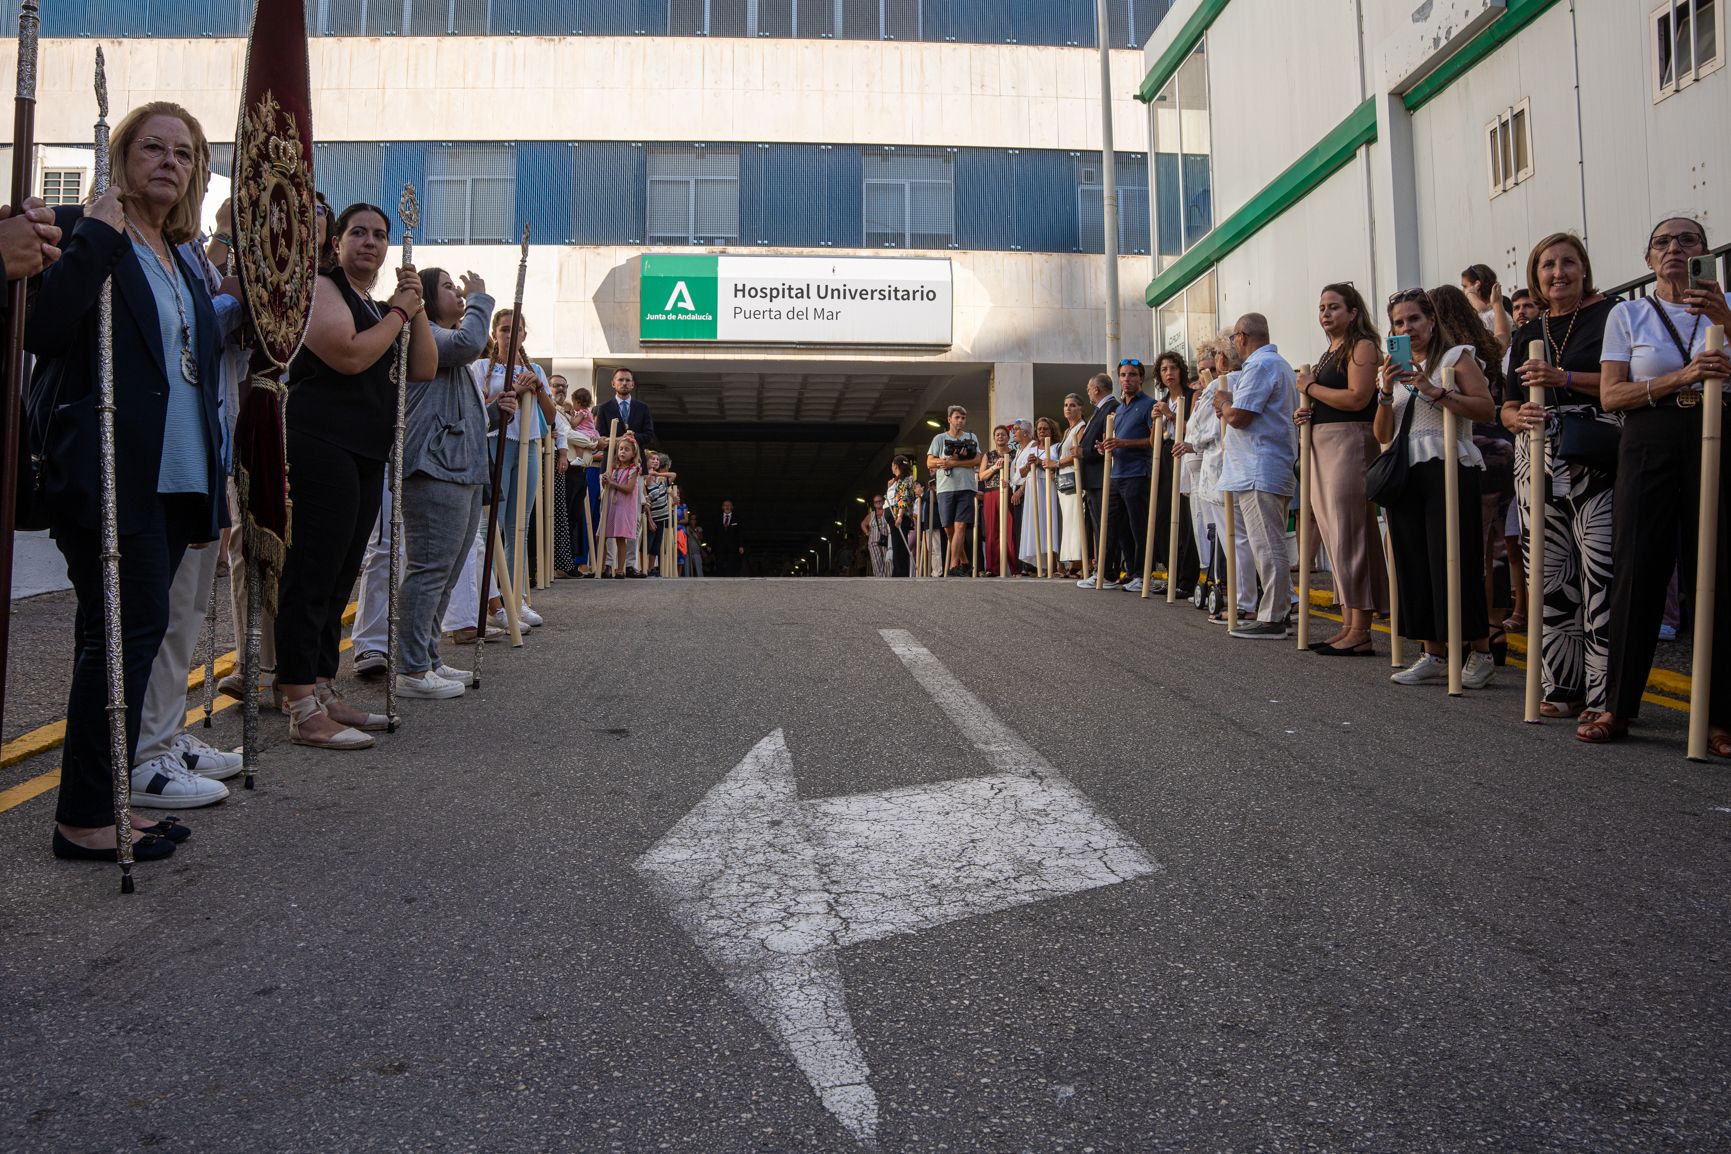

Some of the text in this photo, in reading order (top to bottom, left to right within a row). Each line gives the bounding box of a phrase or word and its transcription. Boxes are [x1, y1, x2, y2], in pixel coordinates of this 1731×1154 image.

[733, 283, 937, 303] Hospital Universitario
[646, 313, 666, 321] Junta
[677, 312, 713, 321] Andalucía
[733, 306, 841, 321] Puerta del Mar
